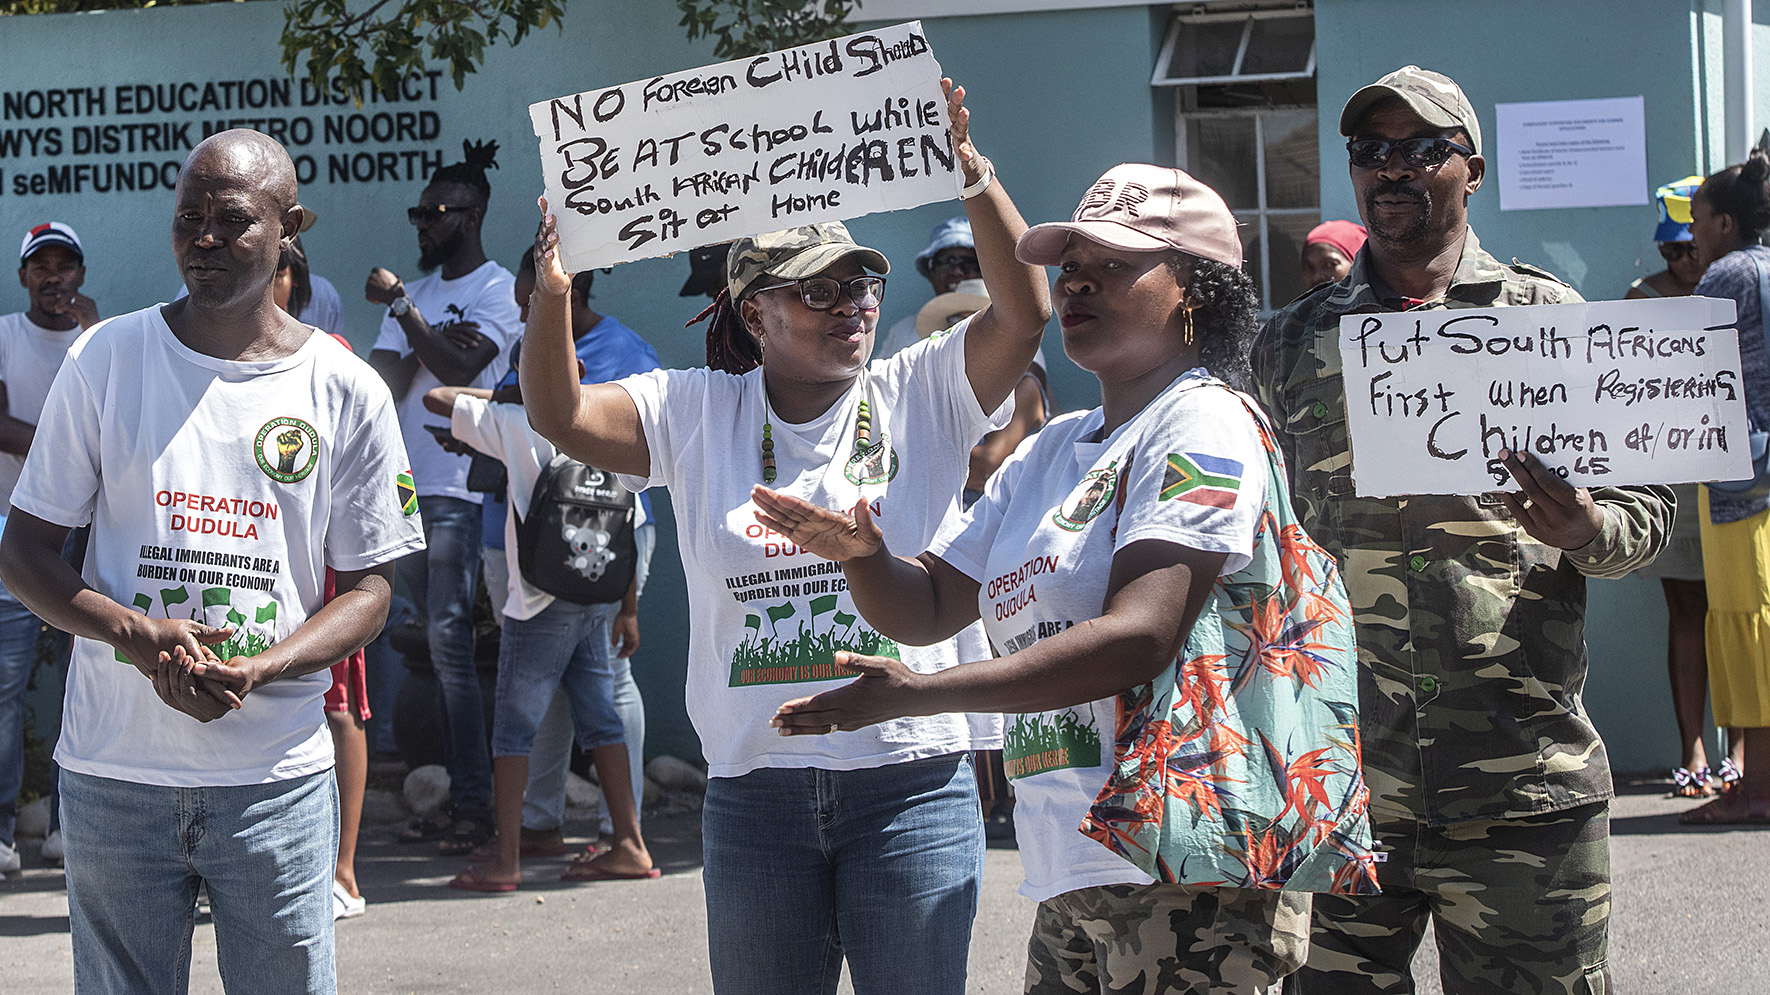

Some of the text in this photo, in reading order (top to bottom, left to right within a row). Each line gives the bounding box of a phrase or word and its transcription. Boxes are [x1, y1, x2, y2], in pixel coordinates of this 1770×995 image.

[3, 69, 443, 120] NORTH EDUCATION DISCT
[0, 127, 63, 158] WYS
[72, 121, 193, 155] DISTRIK
[323, 110, 441, 145] NOORD
[12, 161, 180, 196] seMFUNDO
[328, 149, 443, 184] NORTH
[1081, 178, 1149, 218] BR
[618, 208, 688, 250] Sit
[256, 418, 318, 456] OPERATION DUDULA
[156, 490, 278, 520] OPERATION
[170, 514, 259, 540] DUDULA
[139, 544, 280, 574] ILLEGAL IMMIGRANTS ARE A
[725, 561, 842, 589] ILLEGAL IMMIGRAN
[137, 563, 276, 592] BURDEN ON OUR ECONOMY
[783, 584, 800, 598] ON
[803, 579, 829, 596] OUR
[987, 555, 1060, 600] OPERATION
[995, 584, 1037, 622] DUDULA
[741, 669, 755, 684] OUR
[756, 666, 798, 682] ECONOMY
[799, 665, 810, 680] IS
[811, 663, 832, 679] OUR
[1016, 757, 1025, 776] IS
[1024, 753, 1043, 773] OUR
